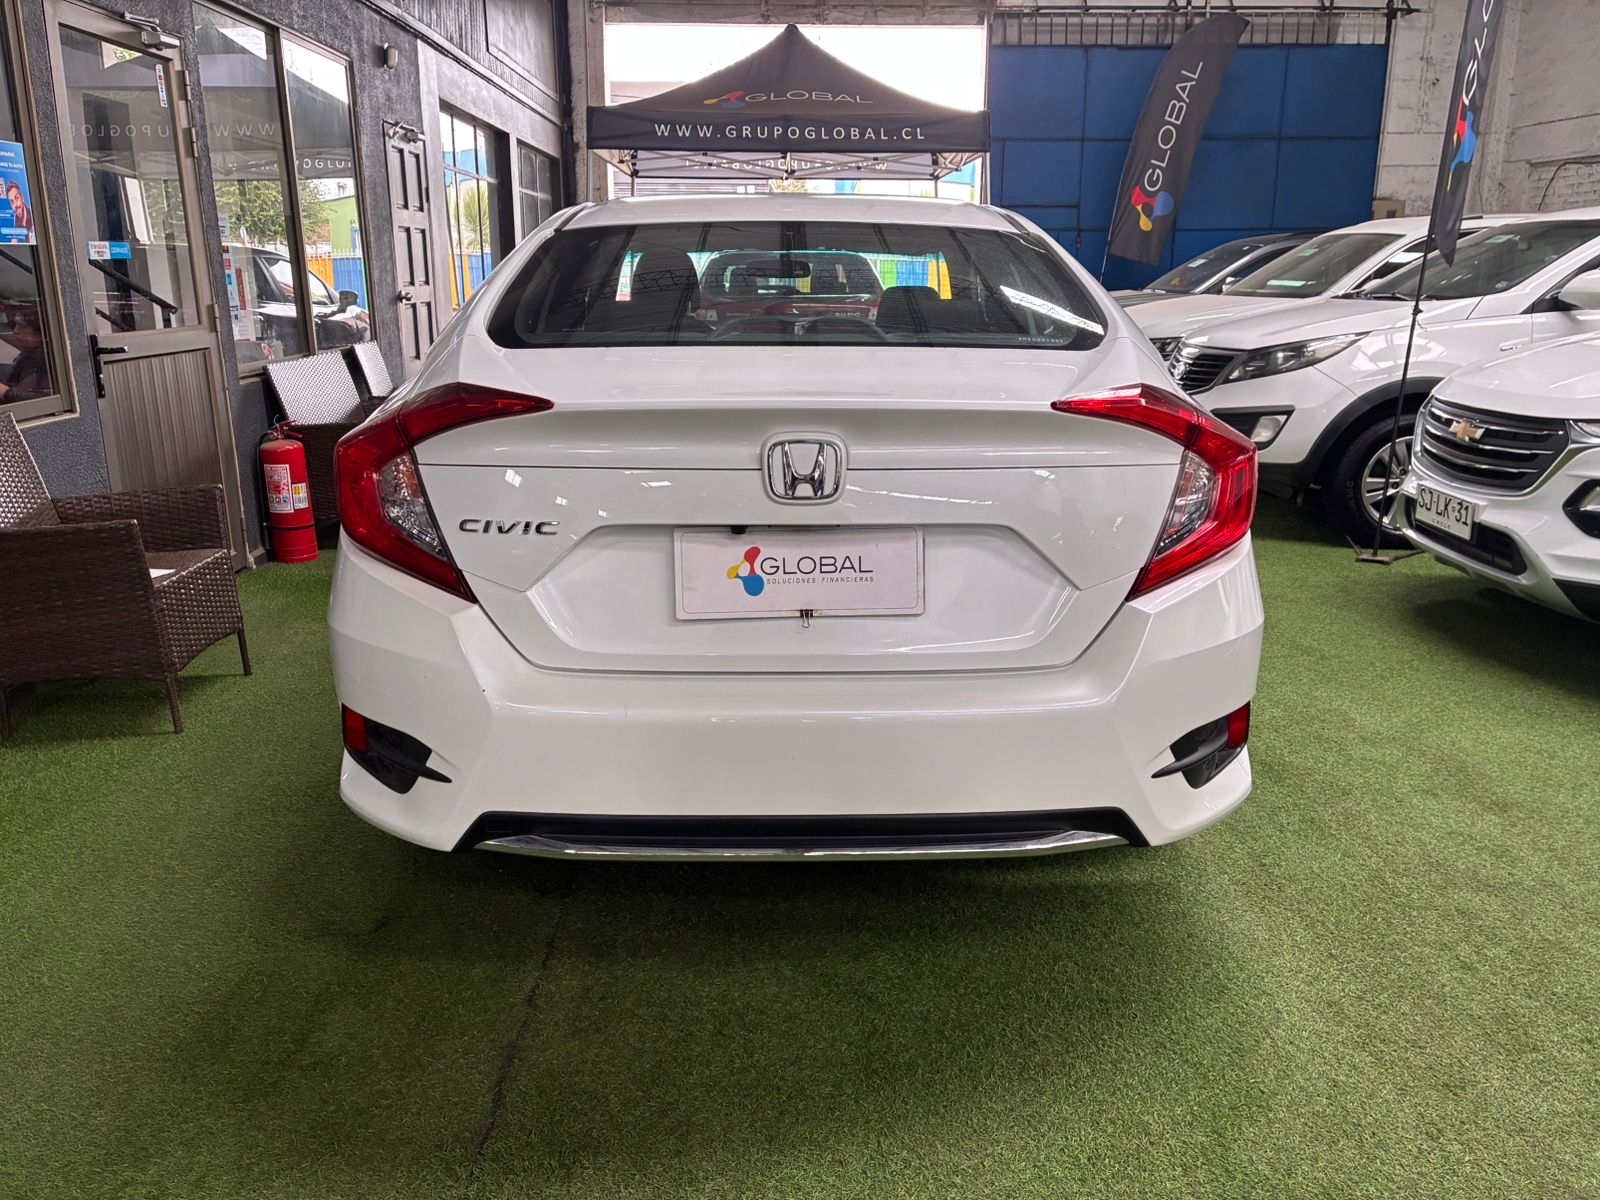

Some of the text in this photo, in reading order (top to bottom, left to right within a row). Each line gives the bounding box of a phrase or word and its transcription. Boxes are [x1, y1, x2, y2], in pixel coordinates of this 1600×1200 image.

[745, 90, 874, 104] GLOBAL
[654, 123, 925, 140] WWW.GRUPOGLOBAL.CL
[1144, 61, 1203, 191] GLOBAL
[459, 519, 561, 535] CIVIC
[760, 555, 874, 575] GLOBAL
[766, 577, 816, 585] SOLUCIONES
